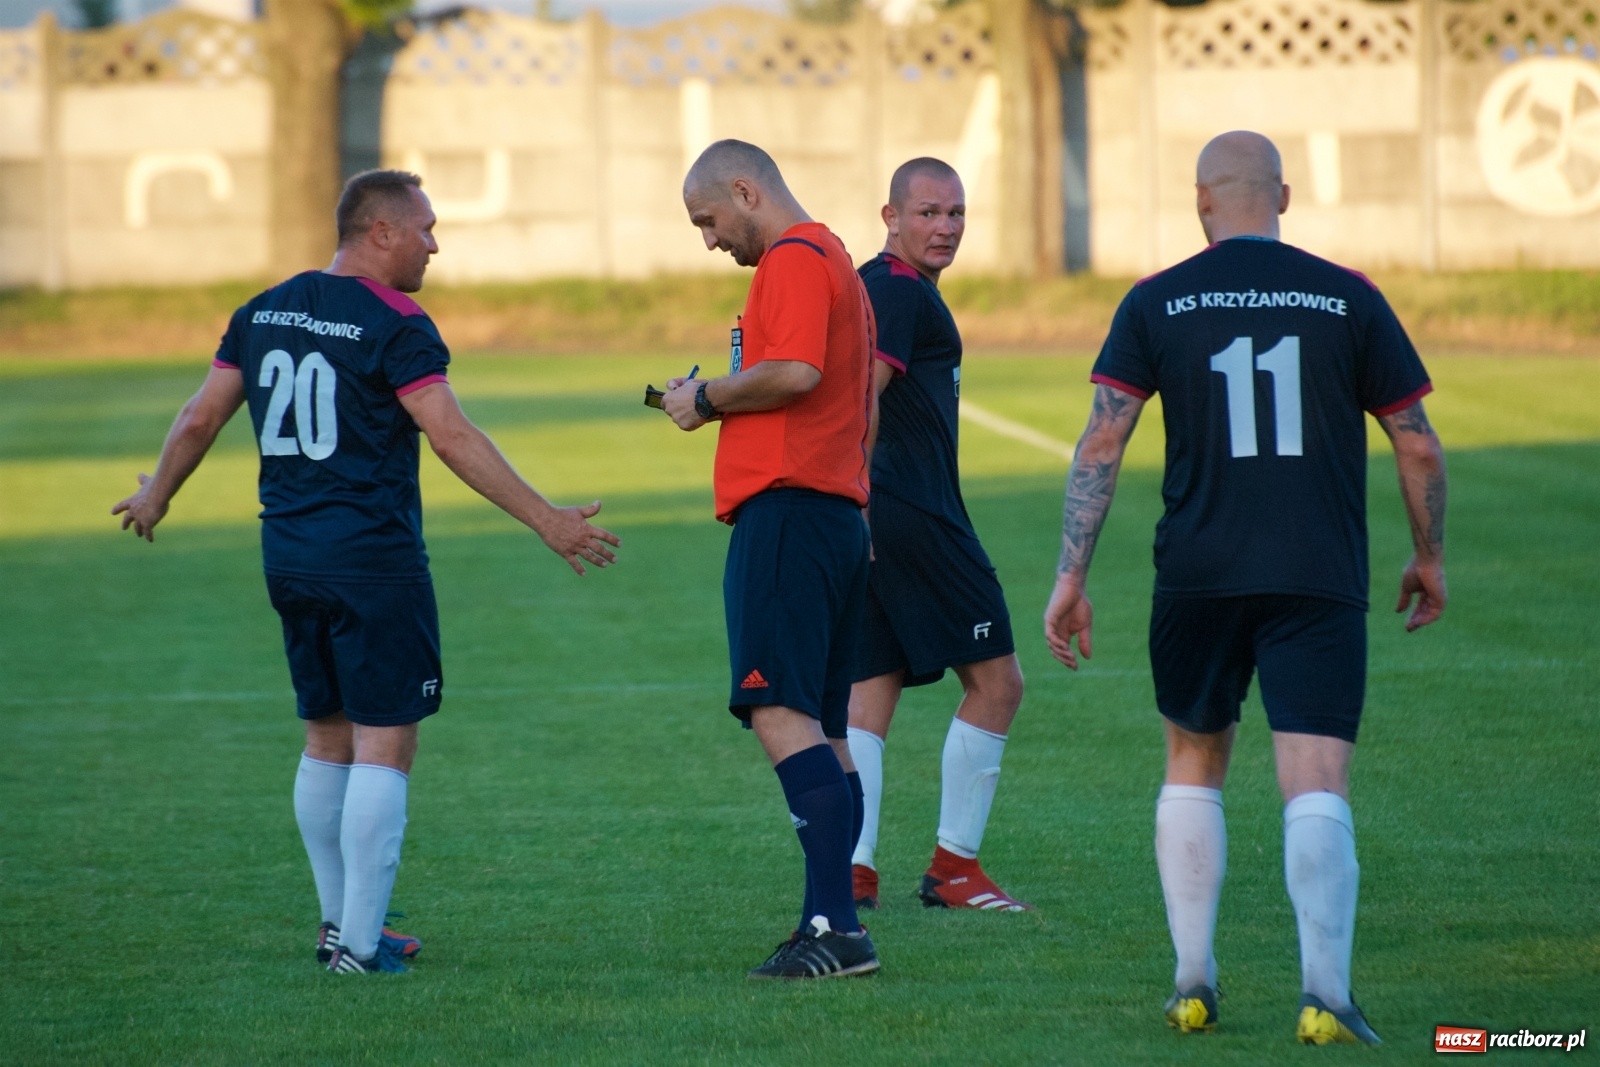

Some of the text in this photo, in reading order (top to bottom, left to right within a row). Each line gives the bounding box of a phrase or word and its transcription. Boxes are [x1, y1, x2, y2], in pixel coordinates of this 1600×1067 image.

[252, 310, 364, 341] LKS KRZYŻANOWICE
[1166, 289, 1348, 316] LKS KRZYŻANOWICE
[258, 349, 338, 460] 20
[1210, 336, 1303, 458] 11
